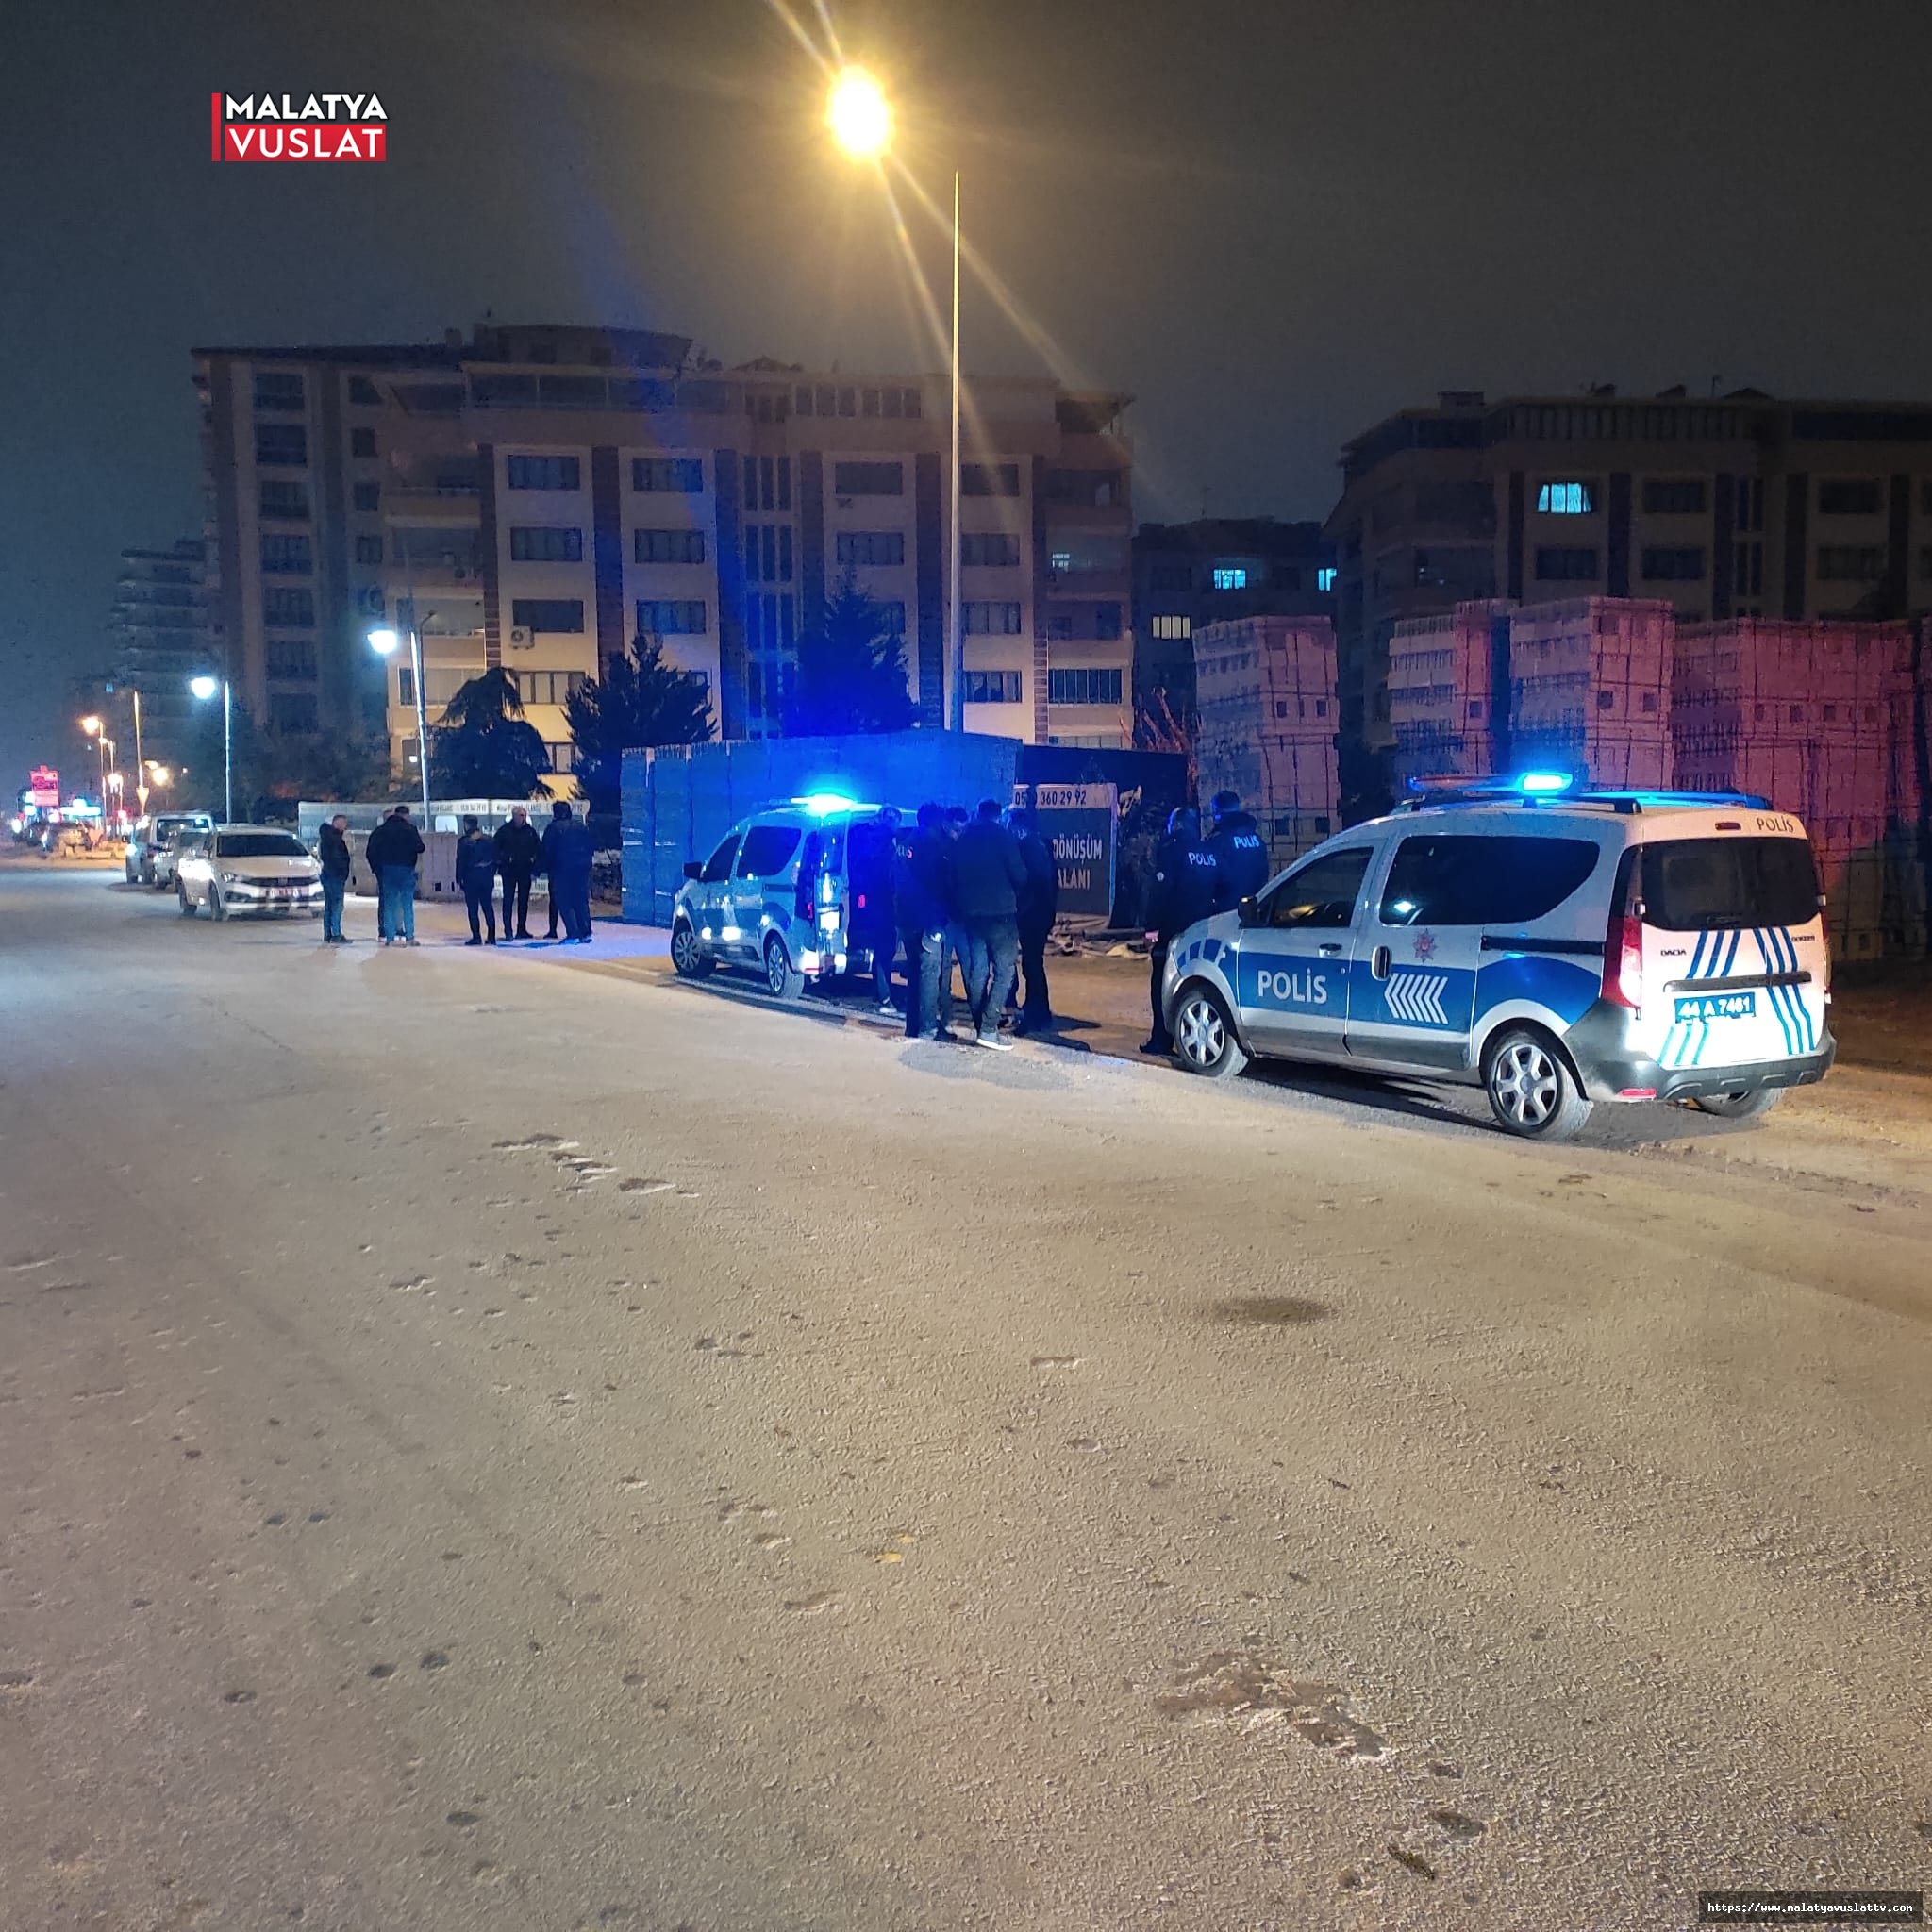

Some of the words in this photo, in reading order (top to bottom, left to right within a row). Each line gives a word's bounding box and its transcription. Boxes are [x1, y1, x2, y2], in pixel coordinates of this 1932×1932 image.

[1040, 791, 1057, 806] 360
[1060, 791, 1072, 806] 29
[1074, 791, 1087, 806] 92
[1052, 833, 1103, 865] DÖNÜŞÜM
[1257, 967, 1327, 1004] POLİS
[1678, 1001, 1701, 1017] 44
[1703, 1000, 1716, 1016] A
